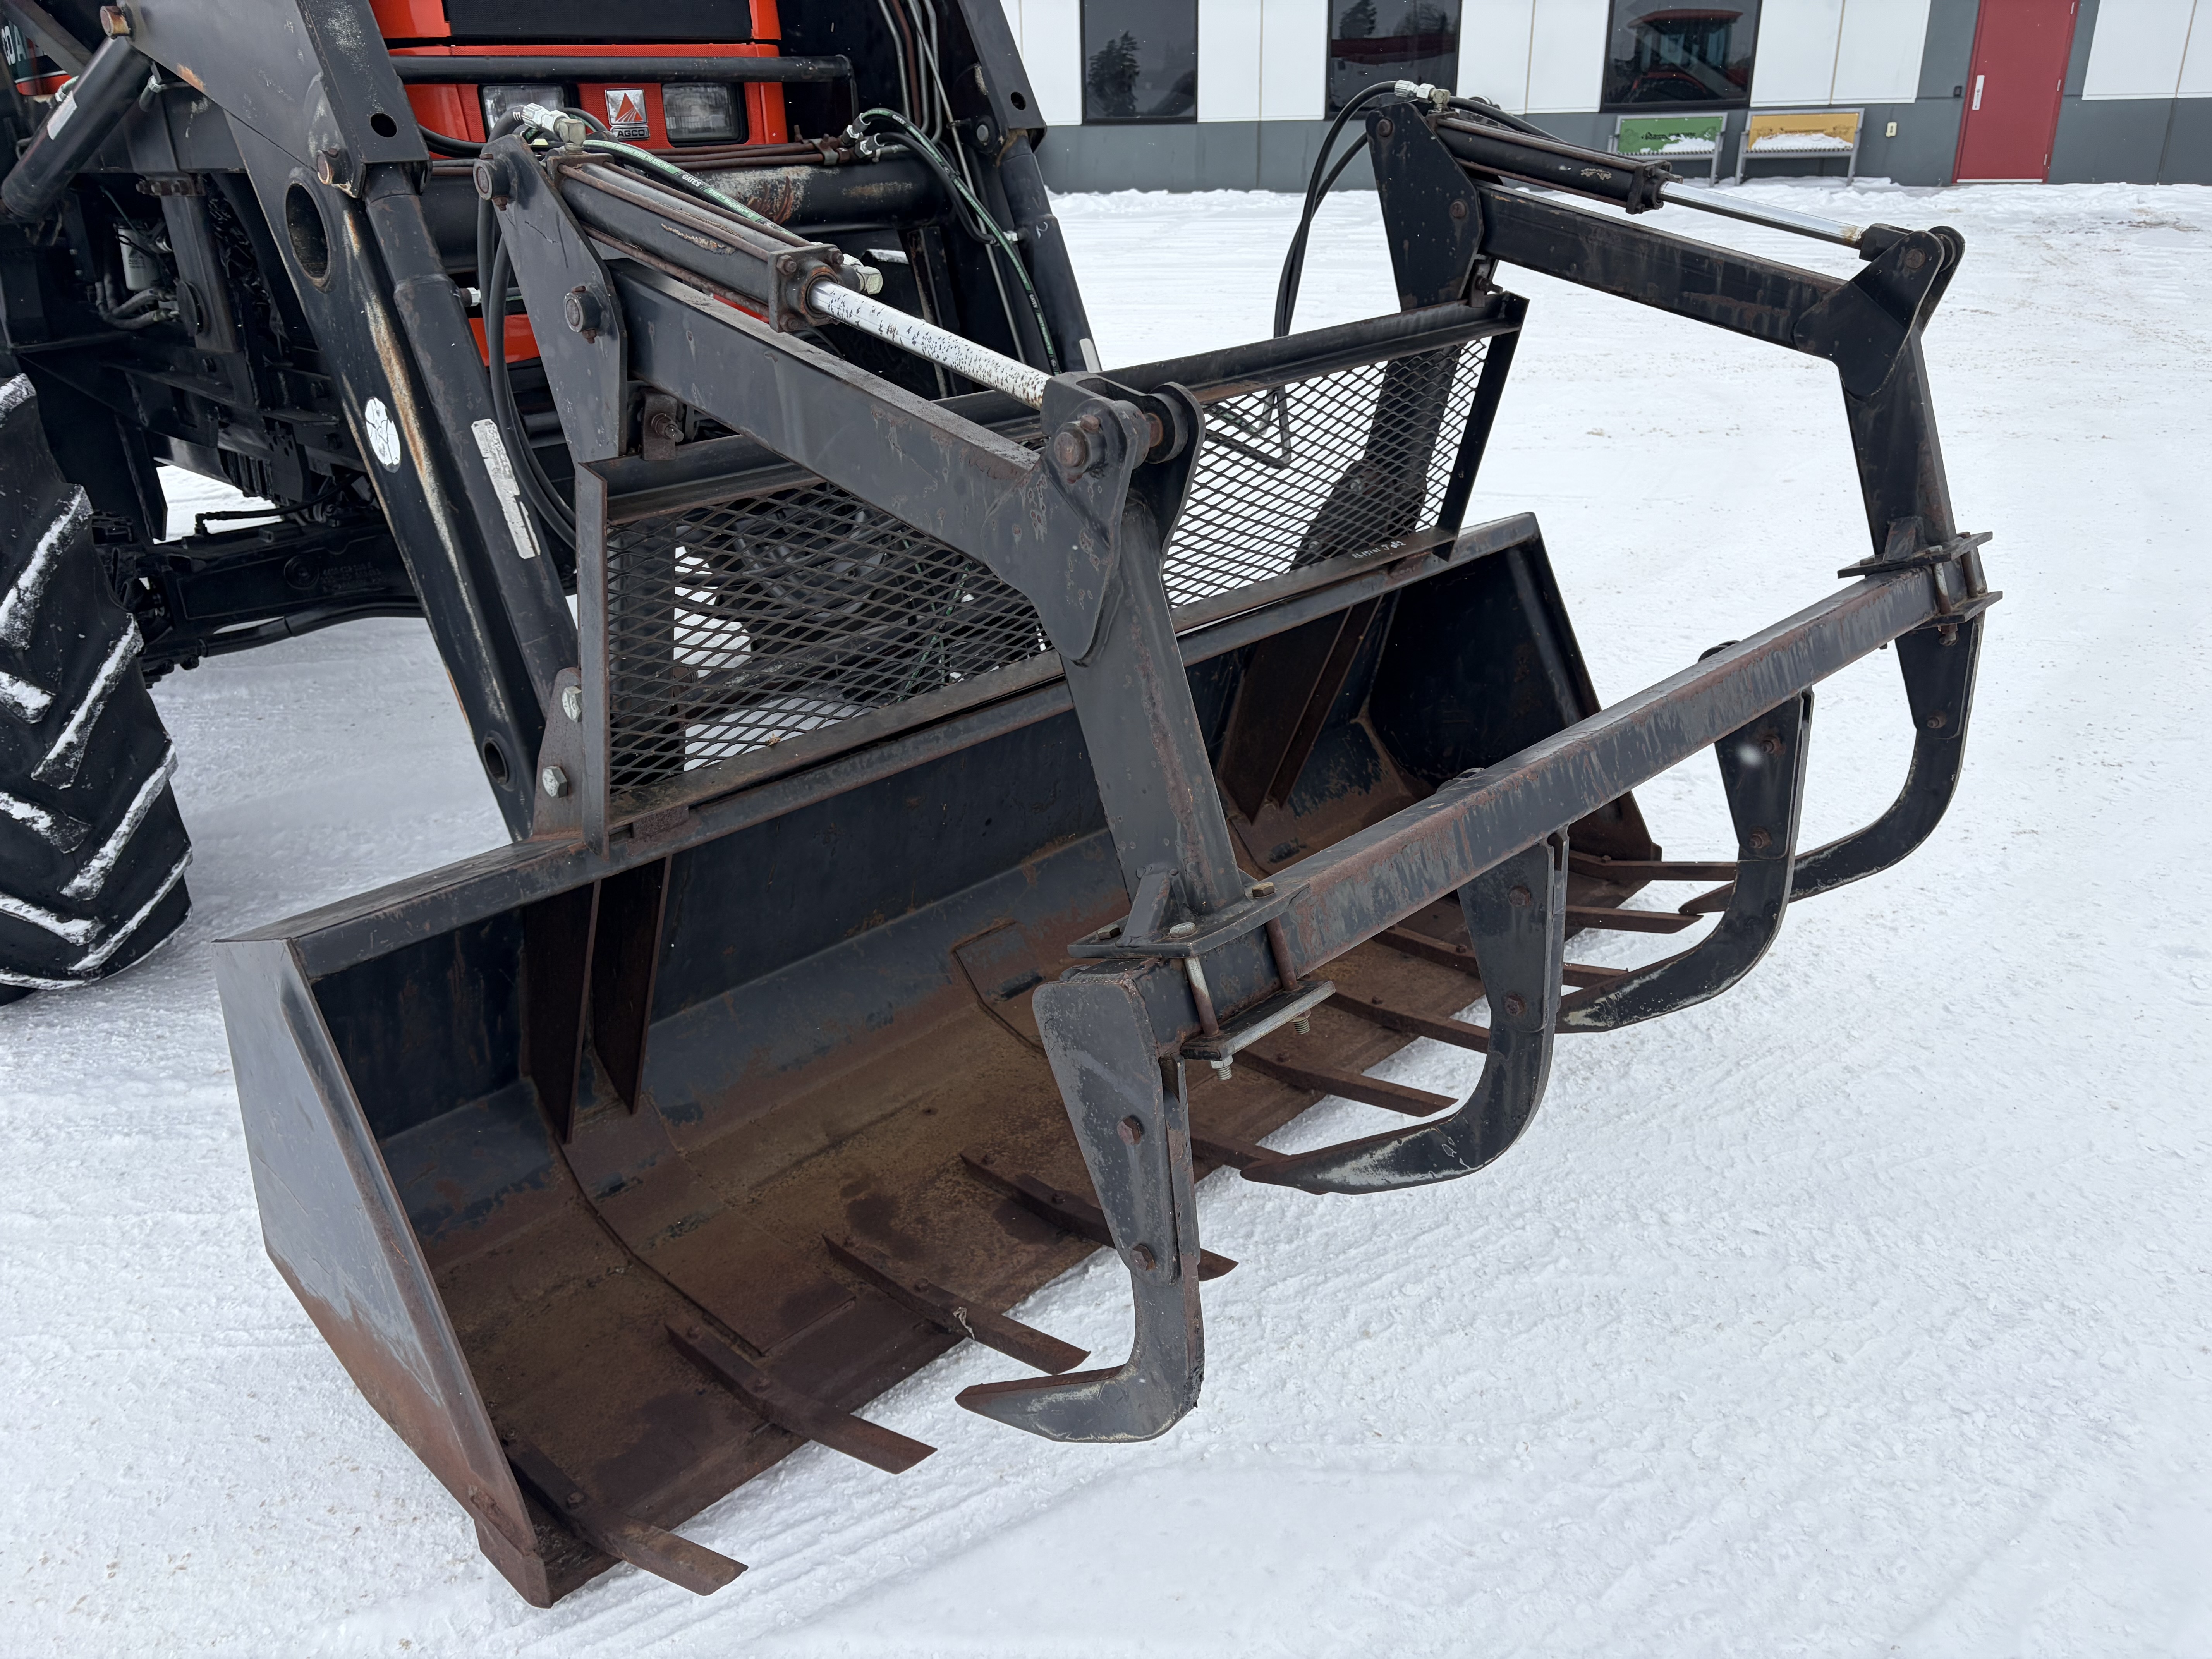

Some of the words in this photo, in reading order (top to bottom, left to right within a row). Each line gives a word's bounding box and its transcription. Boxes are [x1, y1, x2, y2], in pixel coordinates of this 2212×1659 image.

[892, 114, 906, 125] GATES
[617, 129, 645, 138] AGCO
[682, 174, 701, 187] GATES
[1029, 294, 1038, 309] GATES
